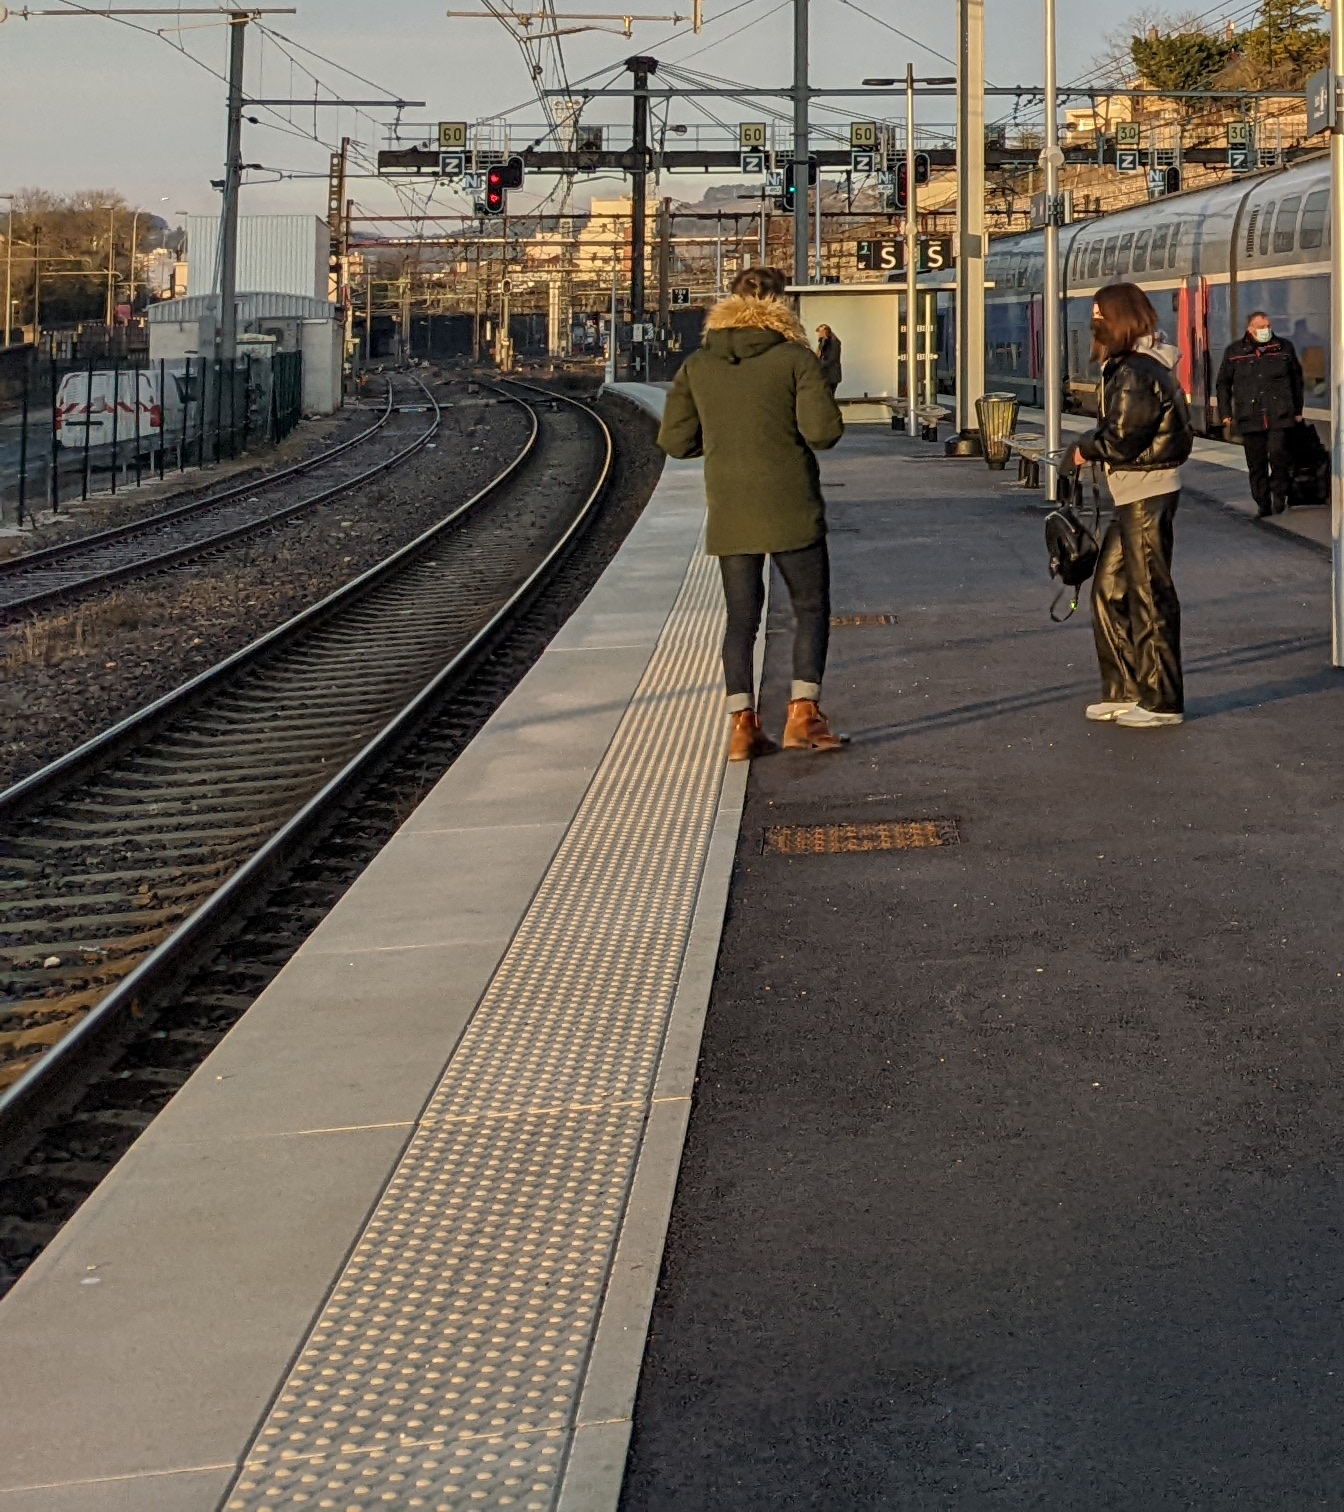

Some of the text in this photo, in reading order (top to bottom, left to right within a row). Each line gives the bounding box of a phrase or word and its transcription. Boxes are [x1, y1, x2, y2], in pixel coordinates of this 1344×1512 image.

[443, 127, 462, 142] 60
[744, 128, 762, 142] 60
[854, 127, 872, 141] 60
[1120, 126, 1136, 140] 30
[445, 158, 460, 173] Z
[745, 158, 760, 171] Z
[856, 156, 870, 170] Z
[1121, 155, 1134, 168] Z
[880, 246, 897, 269] S
[927, 246, 943, 268] S
